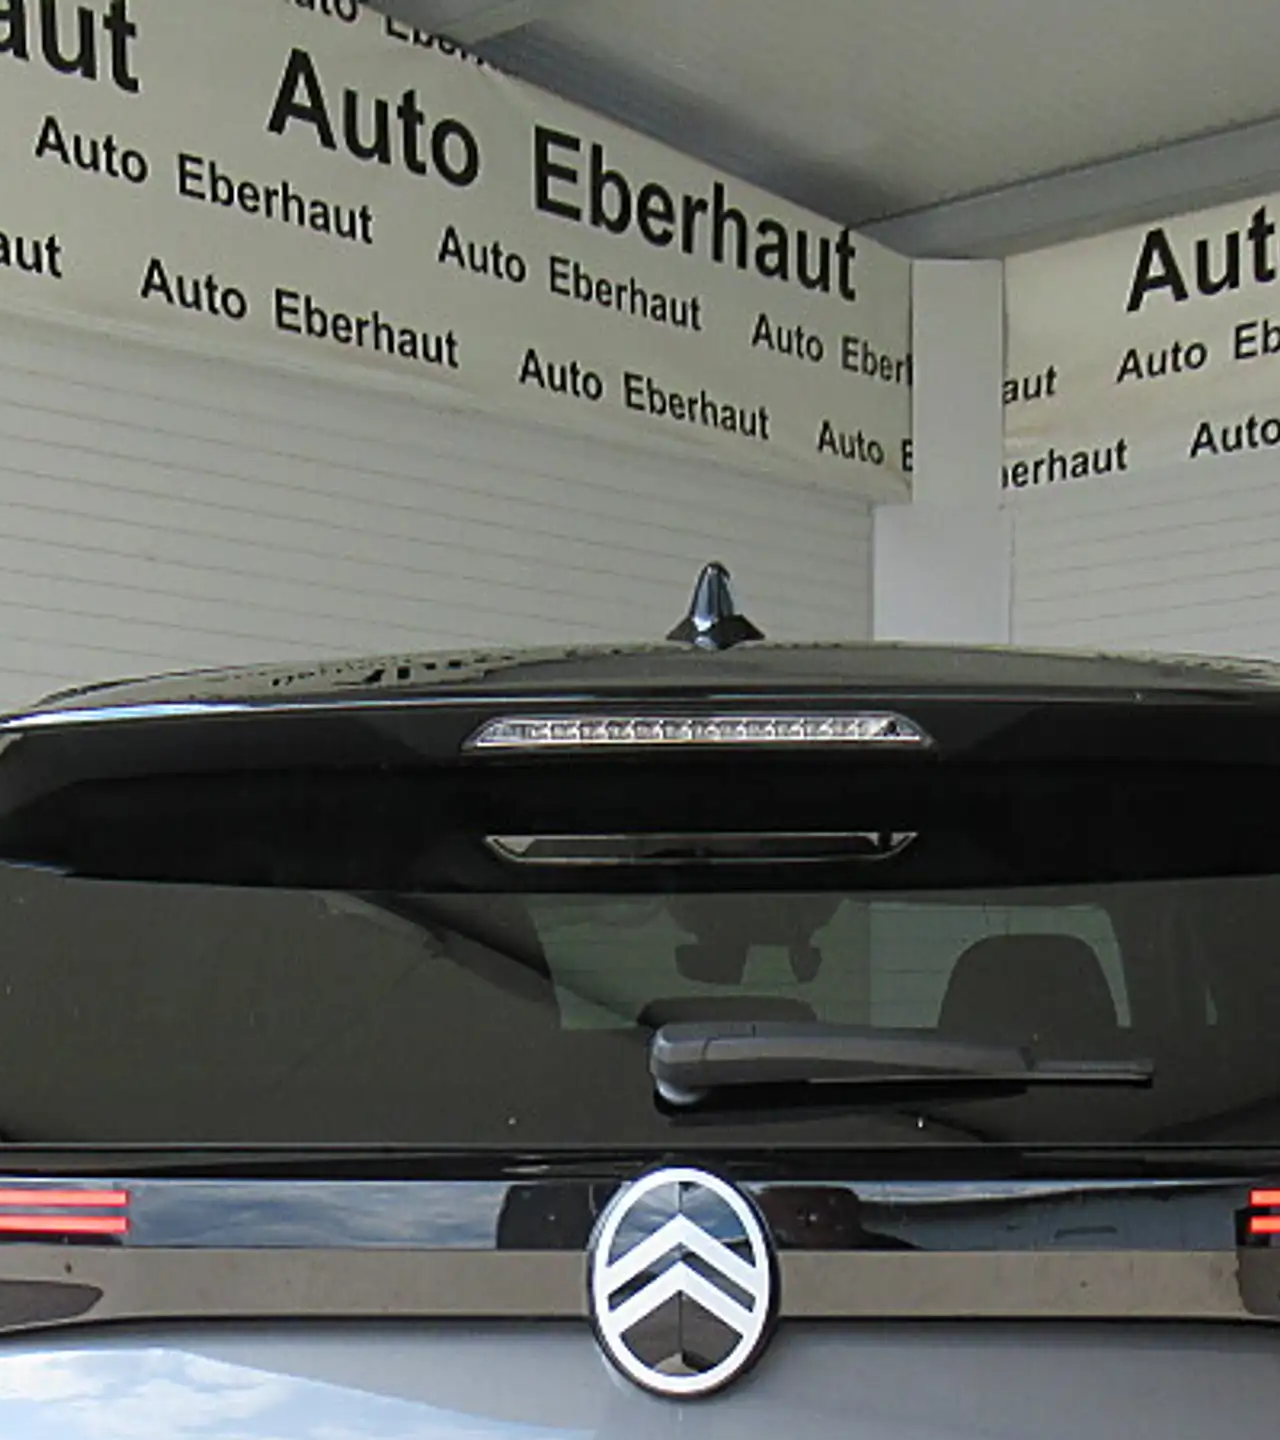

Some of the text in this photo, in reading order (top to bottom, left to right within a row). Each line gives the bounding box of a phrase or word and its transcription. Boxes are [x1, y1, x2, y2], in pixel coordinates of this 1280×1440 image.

[34, 115, 374, 245] Auto Eberhaut
[267, 47, 859, 301] Auto Eberhaut
[139, 257, 459, 369] Auto Eberhaut
[438, 225, 702, 332] Auto Eberhaut
[751, 312, 824, 363] Auto
[1116, 341, 1207, 384] Auto
[519, 348, 770, 441] Auto Eberhaut
[817, 419, 885, 466] Auto
